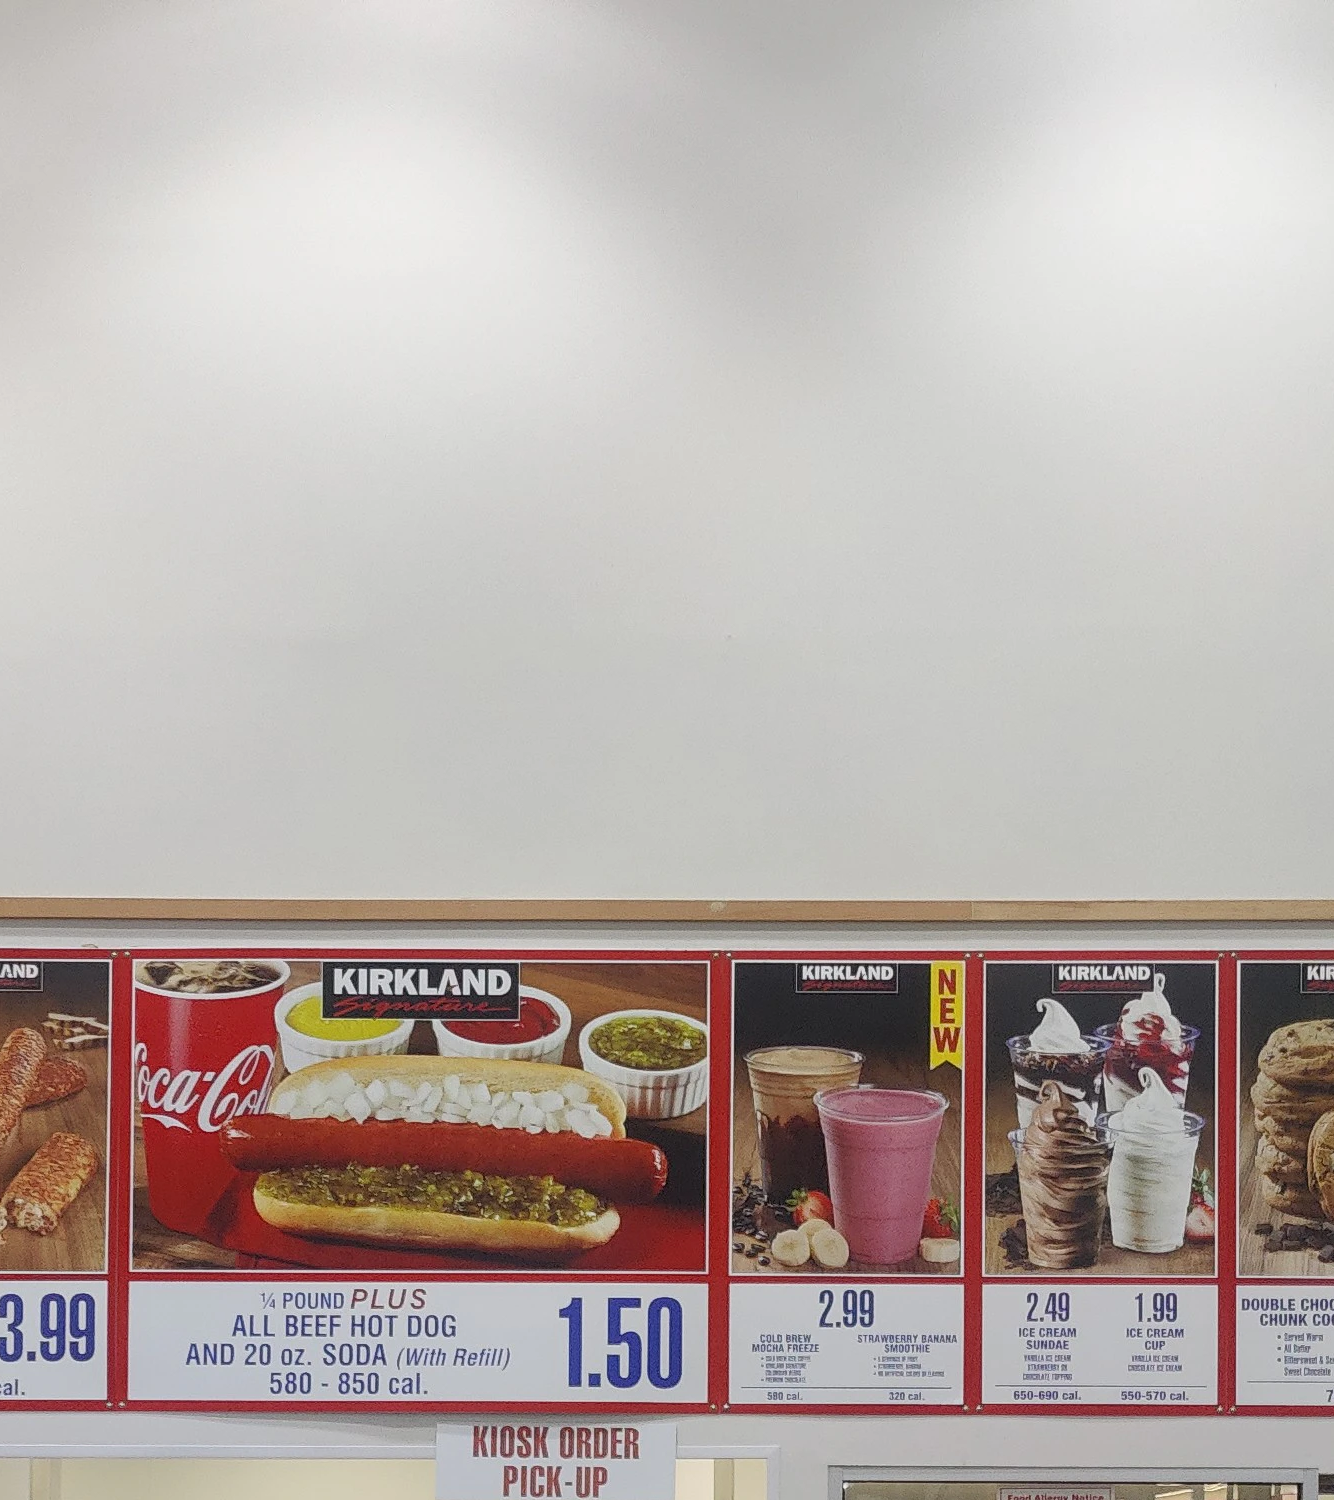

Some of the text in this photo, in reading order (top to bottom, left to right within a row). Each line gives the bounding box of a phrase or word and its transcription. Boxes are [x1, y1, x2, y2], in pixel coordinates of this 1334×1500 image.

[801, 965, 894, 981] KIRKLAND
[1058, 965, 1151, 981] KIRKLAND
[333, 968, 512, 996] KIRKLAND
[333, 996, 512, 1018] Signature
[933, 969, 962, 1053] NEW
[282, 1292, 345, 1310] POUND
[350, 1288, 427, 1310] PLUS
[1241, 1299, 1296, 1311] DOUBLE
[819, 1290, 875, 1328] 2.99
[1026, 1292, 1070, 1323] 2.49
[1134, 1292, 1178, 1323] 1.99
[232, 1315, 457, 1338] ALL BEEF HOT DOG
[1260, 1314, 1308, 1327] CHUNK
[760, 1334, 812, 1344] COLD BREW
[857, 1334, 958, 1344] STRAWBERRY BANANA
[1018, 1328, 1077, 1338] ICE CREAM
[1126, 1328, 1185, 1338] ICE CREAM
[558, 1296, 684, 1390] 1.50
[752, 1344, 820, 1353] MOCHA FREEZE
[884, 1344, 931, 1353] SMOOTHIE
[1026, 1340, 1069, 1350] SUNDAE
[1145, 1340, 1166, 1351] CUP
[186, 1343, 511, 1371] AND 20 oz. SODA (With Refill)
[269, 1372, 312, 1395] 580
[338, 1373, 380, 1395] 850
[388, 1373, 429, 1395] cal.
[889, 1392, 906, 1401] 320
[1014, 1390, 1082, 1401] 650-690 cal.
[1121, 1391, 1189, 1401] 550-570 cal.
[472, 1426, 640, 1460] KIOSK ORDER
[503, 1466, 608, 1498] PICK-UP
